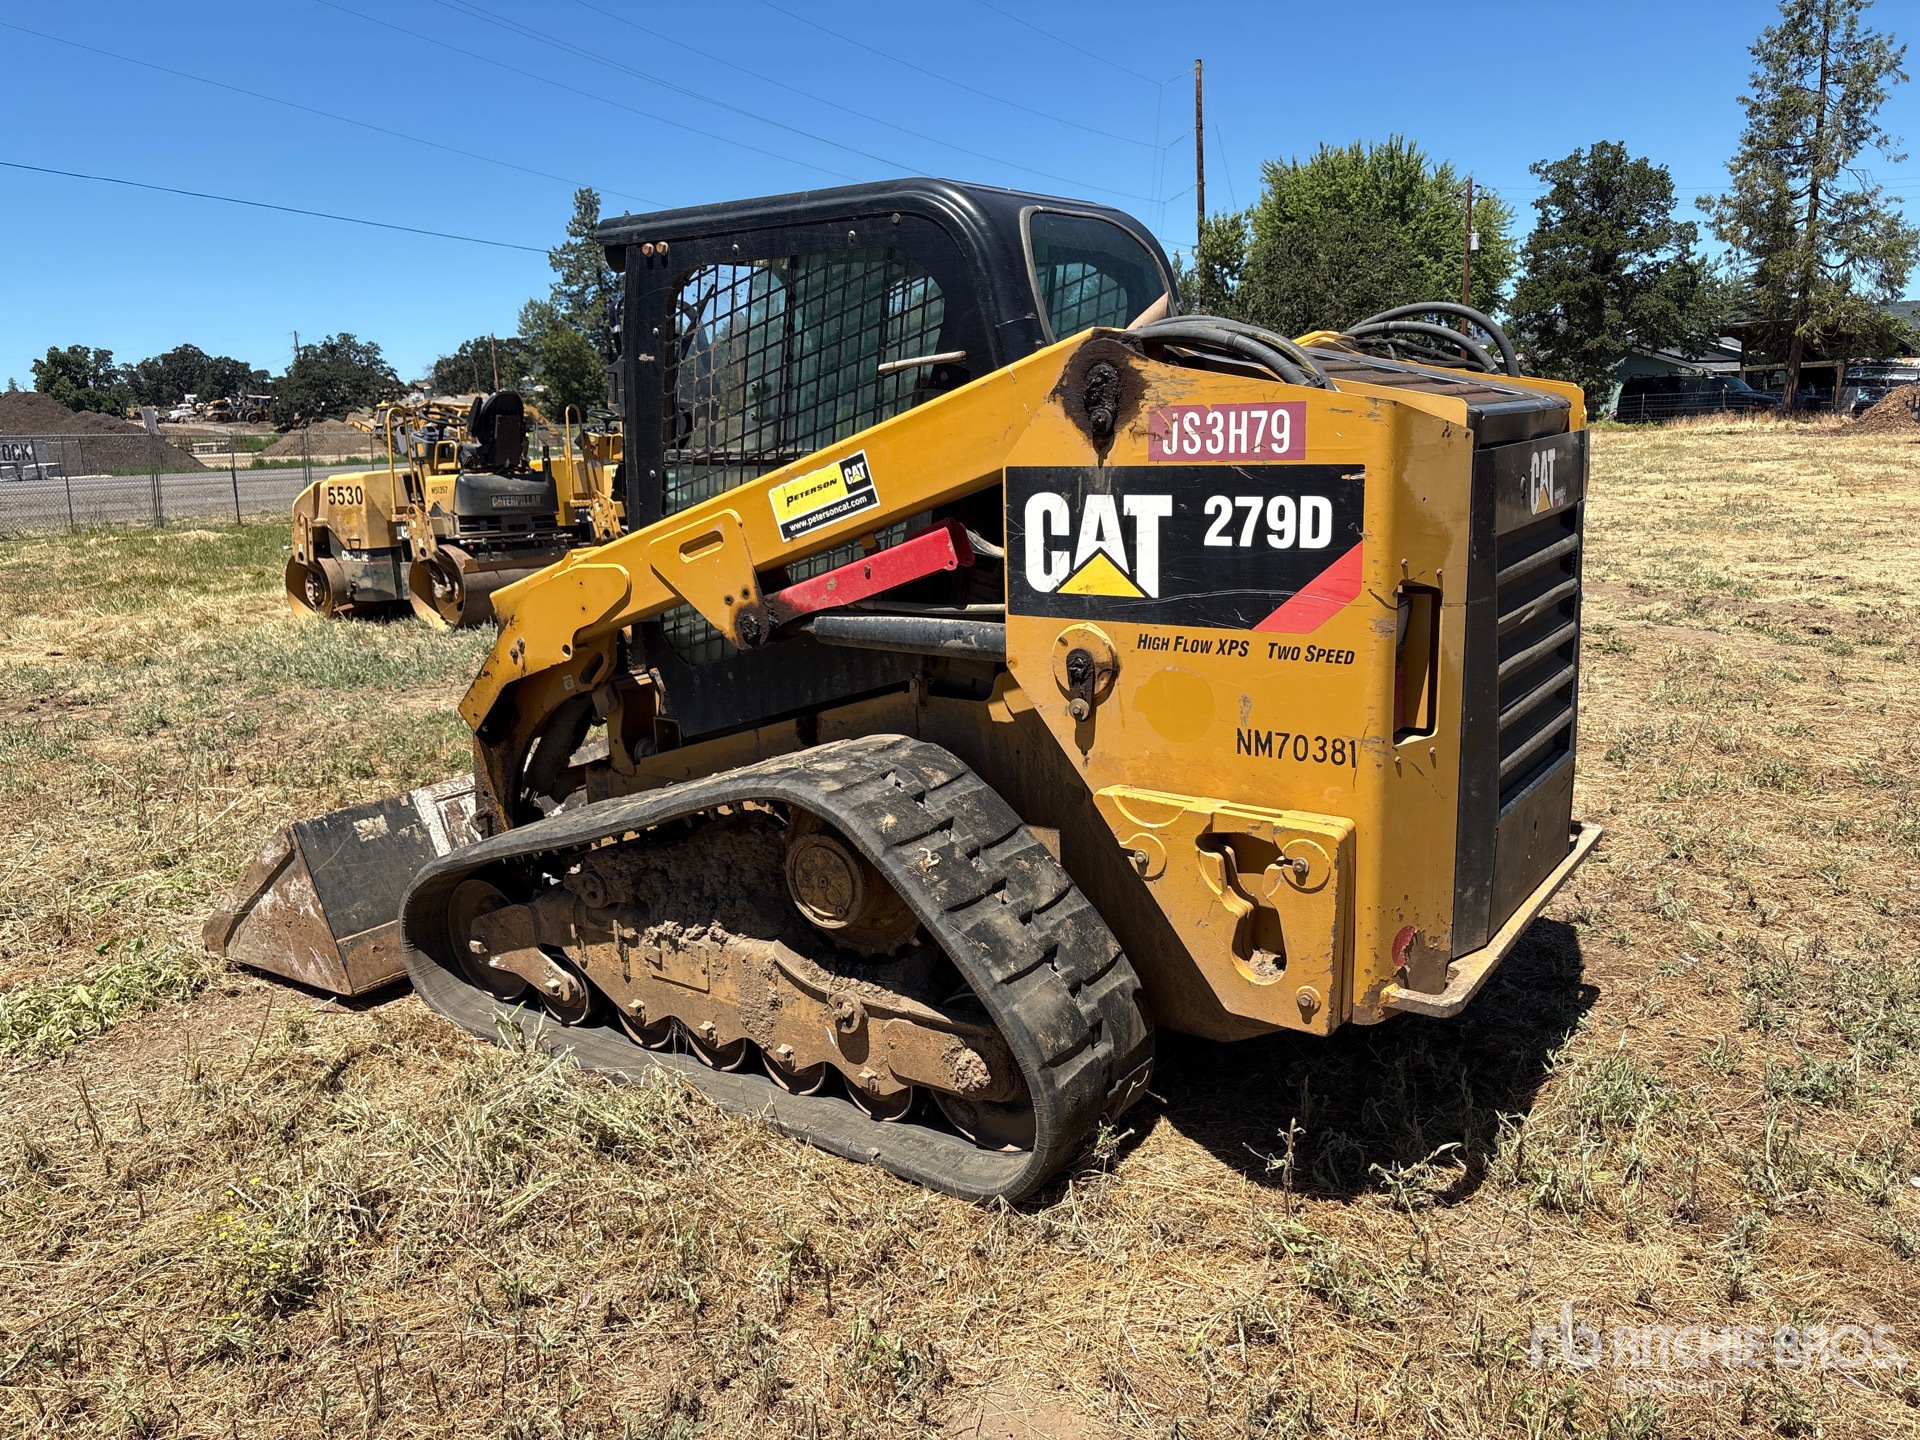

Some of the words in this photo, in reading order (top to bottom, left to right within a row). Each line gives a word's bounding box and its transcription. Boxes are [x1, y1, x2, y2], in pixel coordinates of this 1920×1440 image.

[1162, 408, 1291, 455] JS3H79
[327, 485, 363, 506] 5530
[786, 478, 838, 508] PETERSON
[844, 462, 866, 485] CAT
[1530, 447, 1556, 516] CAT
[491, 495, 542, 508] CATERPILLAR
[788, 495, 868, 532] www.petersoncat.com
[1024, 491, 1173, 599] CAT
[1203, 494, 1333, 550] 279D
[1137, 633, 1170, 652] HIGH
[1173, 635, 1214, 655] FLOW
[1216, 638, 1251, 658] XPS
[1267, 642, 1302, 662] TWO
[1304, 644, 1356, 666] SPEED
[1236, 727, 1357, 769] NM70381
